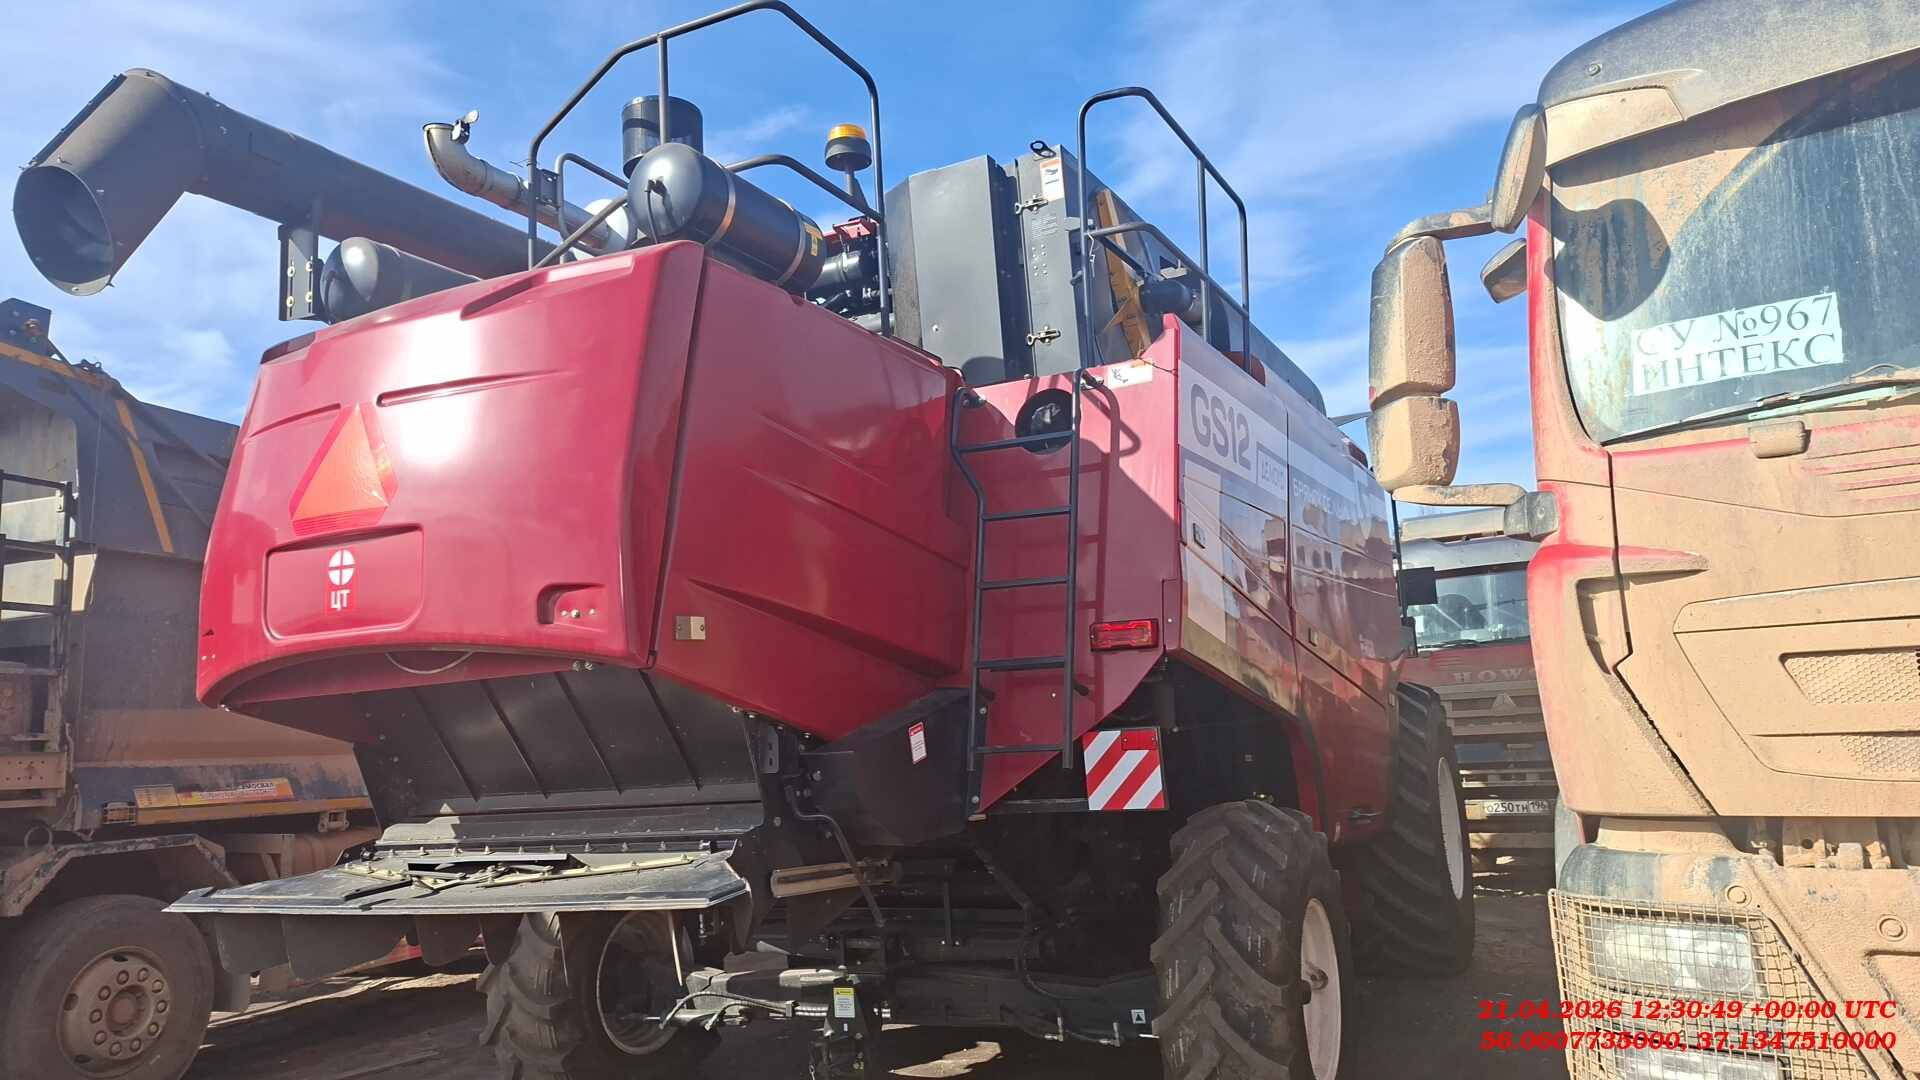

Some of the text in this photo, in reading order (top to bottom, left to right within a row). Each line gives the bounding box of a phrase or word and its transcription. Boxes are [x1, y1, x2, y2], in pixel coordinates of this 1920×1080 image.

[1712, 294, 1834, 343] №967
[1191, 383, 1251, 471] GS12
[331, 589, 351, 611] ЦТ
[1453, 667, 1535, 683] HOW
